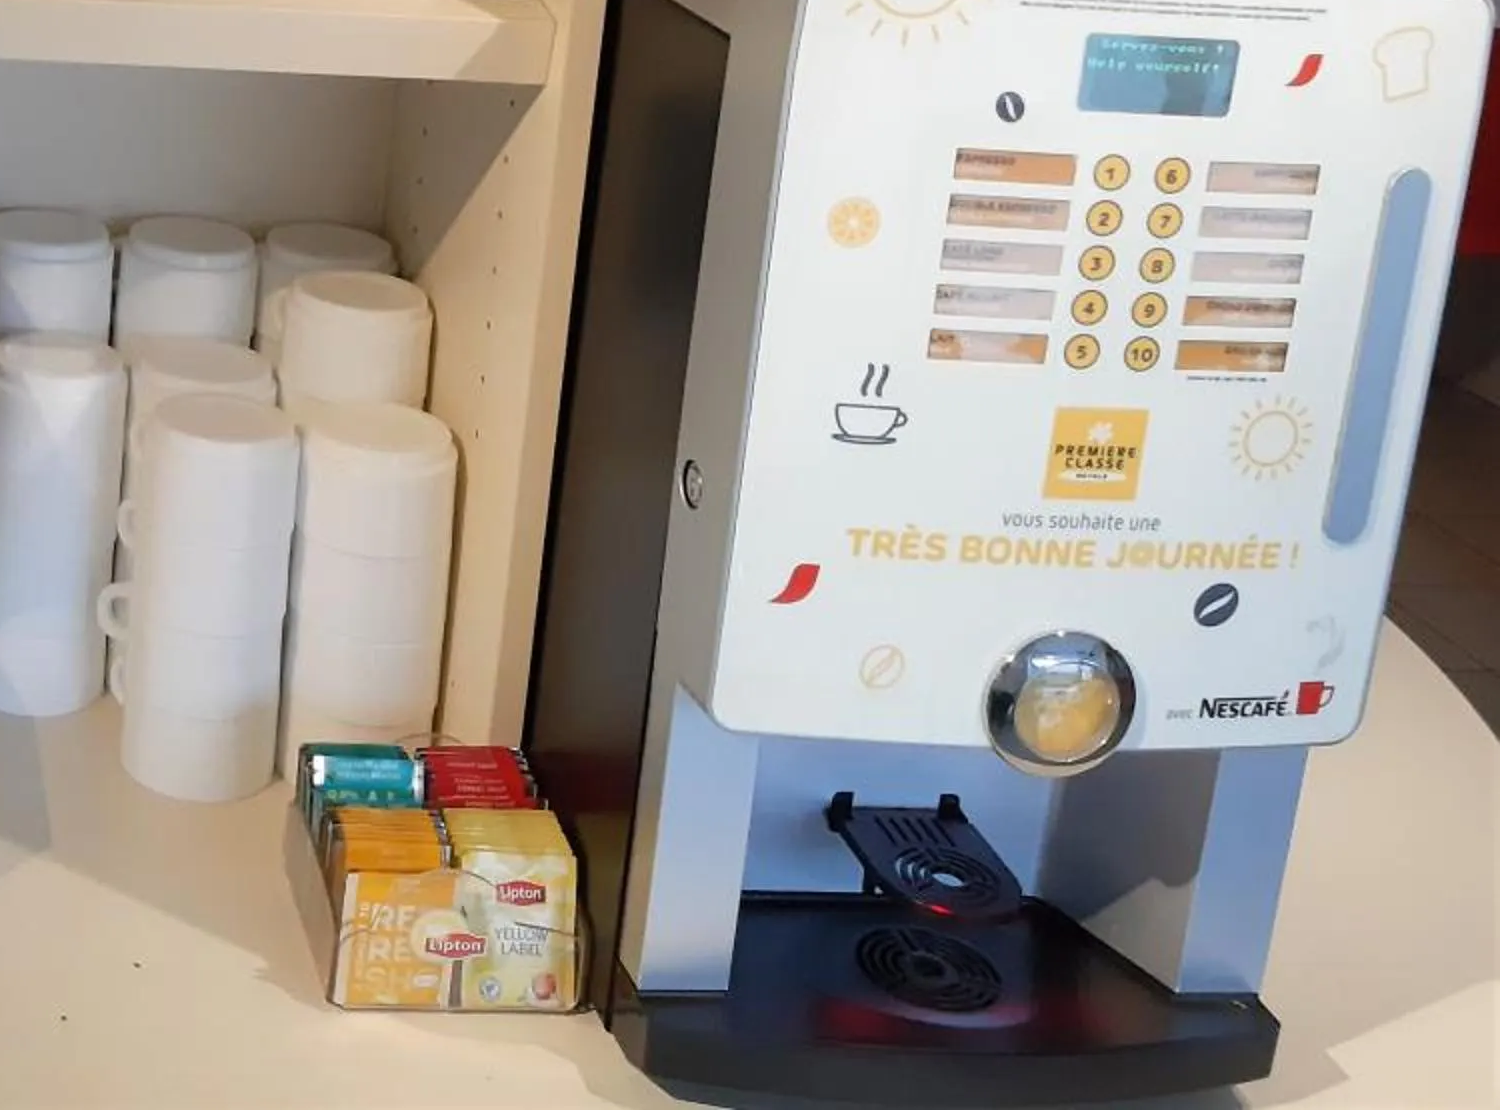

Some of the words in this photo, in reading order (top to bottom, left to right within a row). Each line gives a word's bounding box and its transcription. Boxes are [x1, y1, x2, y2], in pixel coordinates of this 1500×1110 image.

[1104, 167, 1115, 181] 1
[1165, 169, 1178, 184] 6
[1098, 212, 1110, 226] 2
[1159, 215, 1171, 228] 7
[1090, 257, 1102, 271] 3
[1151, 260, 1164, 274] 8
[1083, 302, 1095, 315] 4
[1143, 303, 1156, 318] 9
[1075, 345, 1087, 359] 5
[1131, 347, 1153, 363] 10
[1065, 458, 1125, 470] CLASSE
[1002, 512, 1043, 529] vous
[1048, 512, 1125, 531] souhaite
[1129, 516, 1162, 532] une
[846, 523, 948, 563] TRÈS
[959, 534, 1097, 569] BONNE
[1106, 534, 1282, 570] JOURNÉE
[1199, 689, 1290, 719] NESCAFÉ
[499, 885, 542, 901] Lipton
[429, 938, 483, 956] Lipton
[501, 941, 543, 957] LABEL
